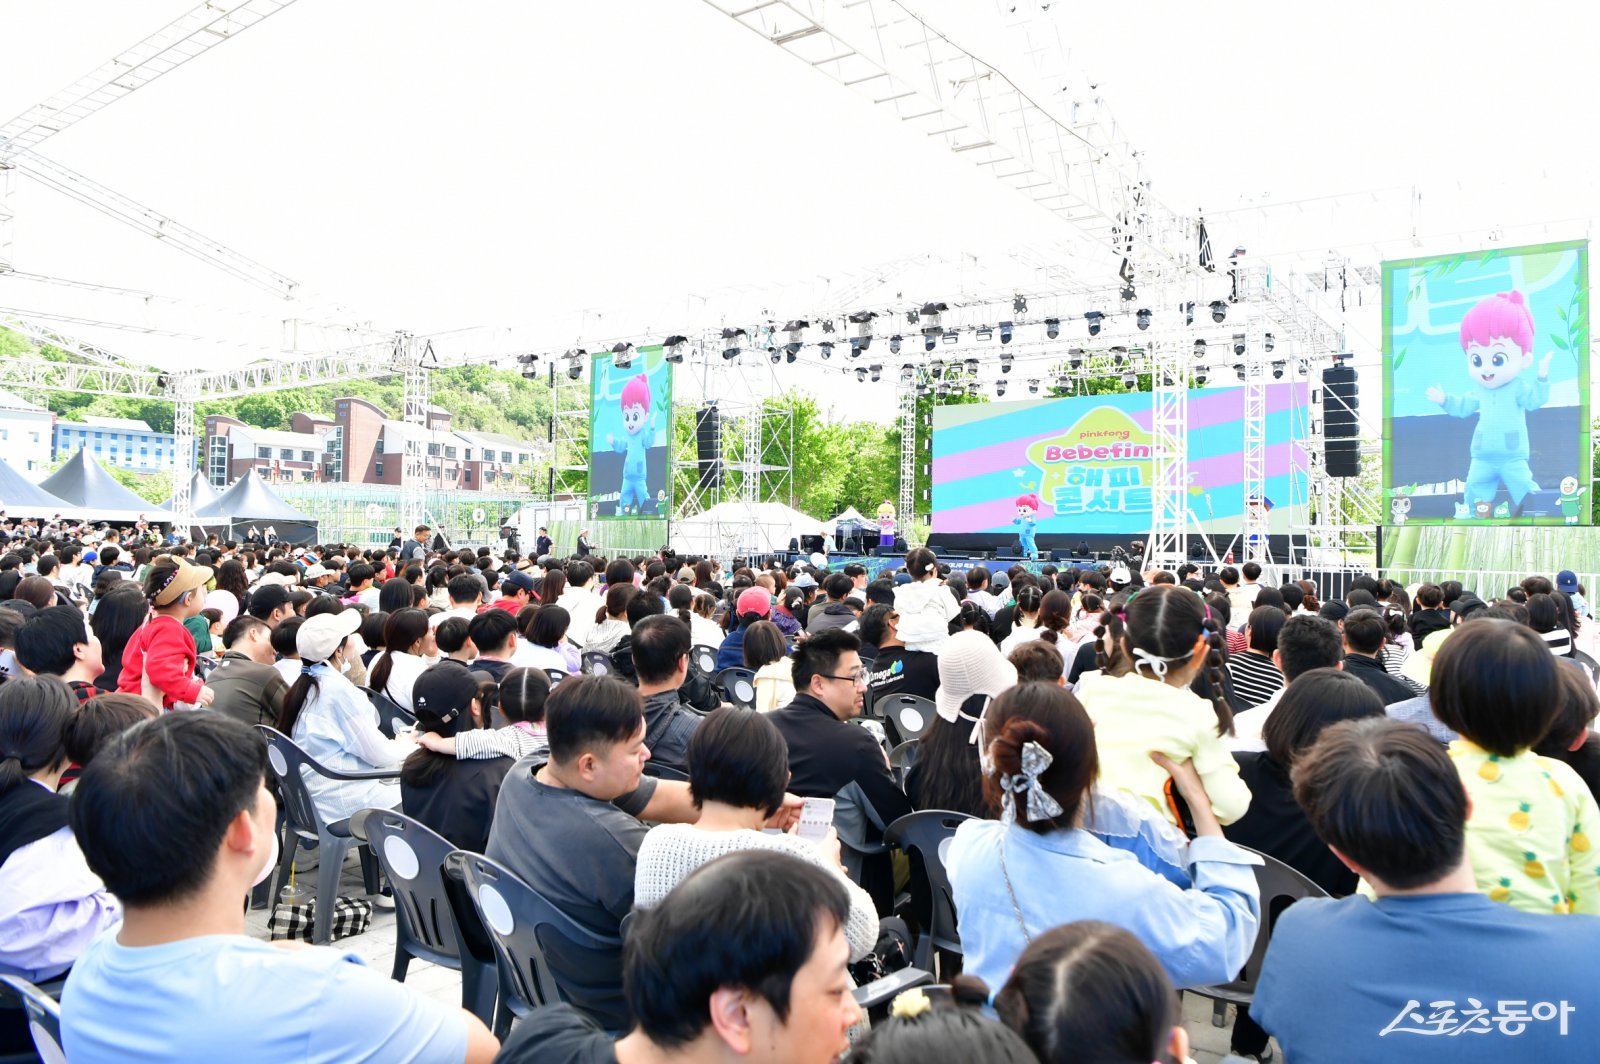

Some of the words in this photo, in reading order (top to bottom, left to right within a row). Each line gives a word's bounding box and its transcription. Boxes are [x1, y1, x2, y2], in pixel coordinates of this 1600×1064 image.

[1079, 430, 1131, 440] pinkfong
[1066, 465, 1141, 488] 해피
[1055, 486, 1153, 512] 콘서트
